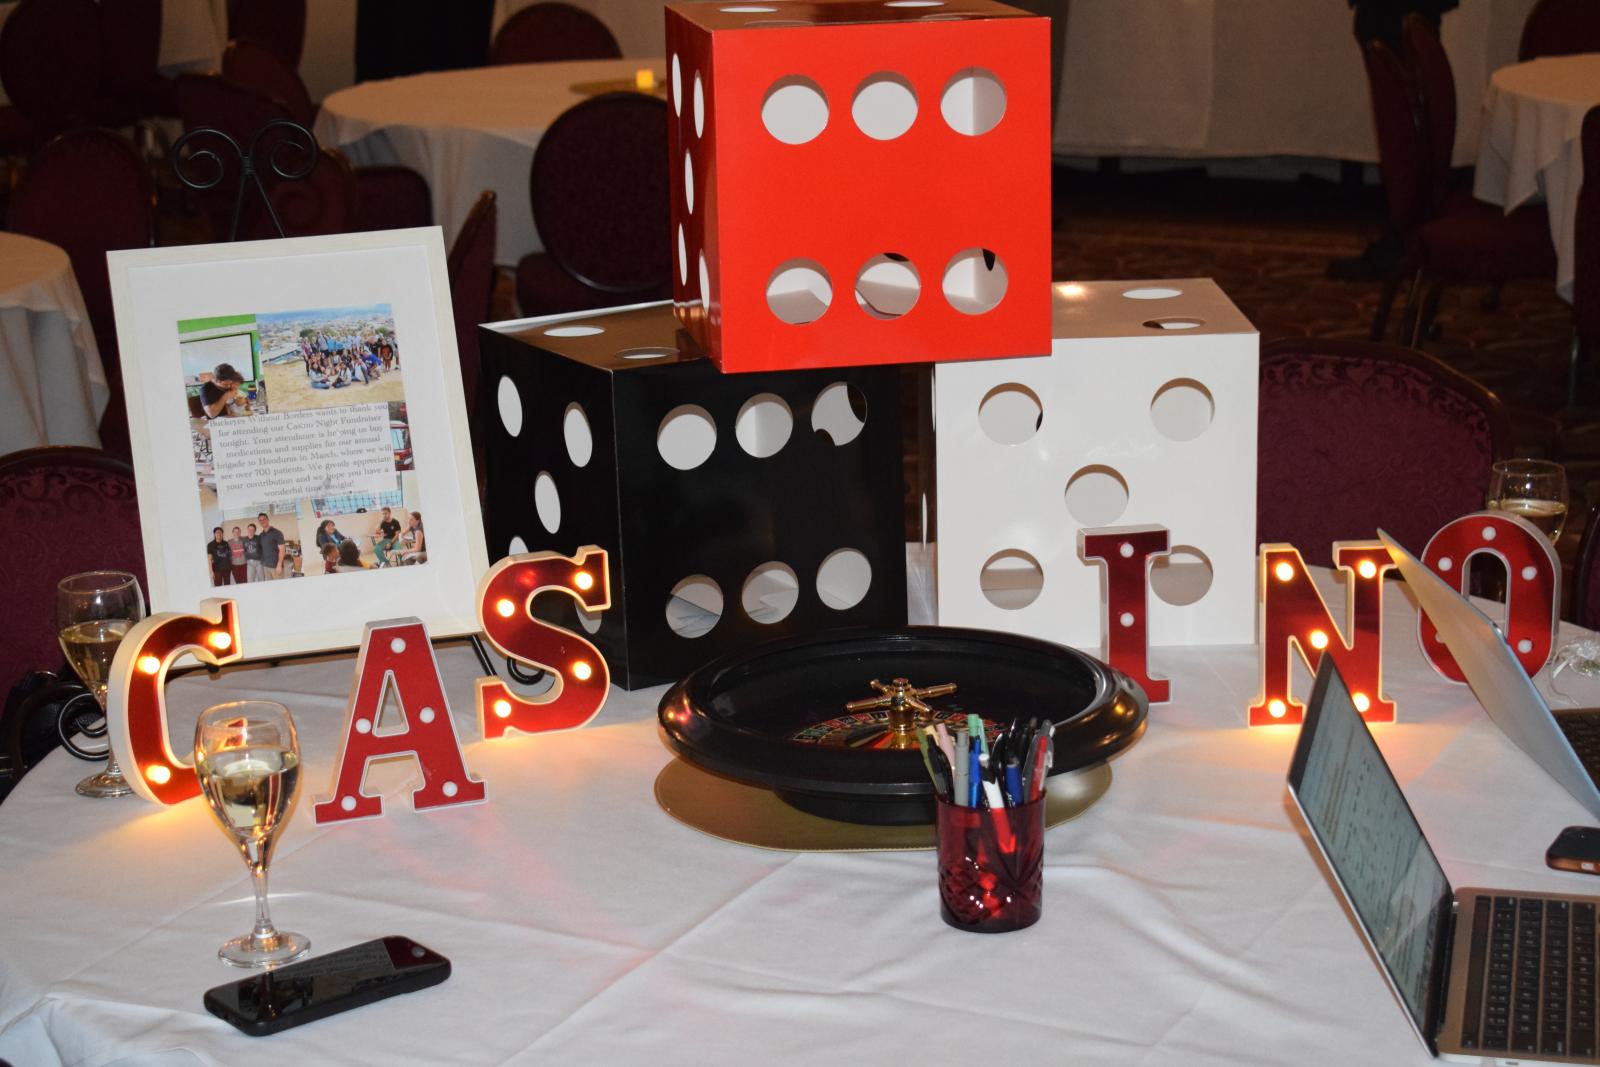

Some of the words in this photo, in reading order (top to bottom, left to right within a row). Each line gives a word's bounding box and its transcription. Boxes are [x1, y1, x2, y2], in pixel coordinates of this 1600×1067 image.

[249, 414, 280, 423] Without
[284, 410, 313, 420] Borders
[350, 404, 370, 413] thank
[374, 403, 388, 411] you
[218, 429, 229, 437] for
[232, 426, 268, 436] attending
[316, 418, 338, 428] Night
[341, 414, 382, 424] Fundraiser
[220, 440, 248, 448] tonight.
[253, 436, 272, 445] Your
[274, 432, 317, 442] attendance
[370, 424, 382, 433] buy
[226, 447, 272, 458] medications
[274, 445, 288, 453] and
[292, 441, 322, 452] supplies
[326, 440, 336, 448] for
[355, 435, 380, 445] annual
[259, 456, 296, 466] Honduras
[341, 448, 363, 456] where
[378, 444, 392, 452] will
[256, 468, 270, 476] 700
[326, 460, 349, 470] greatly
[353, 456, 391, 467] appreciate
[226, 483, 243, 492] your
[246, 478, 293, 489] contribution
[296, 475, 310, 484] and
[348, 470, 361, 478] you
[264, 486, 303, 497] wonderful
[306, 484, 322, 493] time
